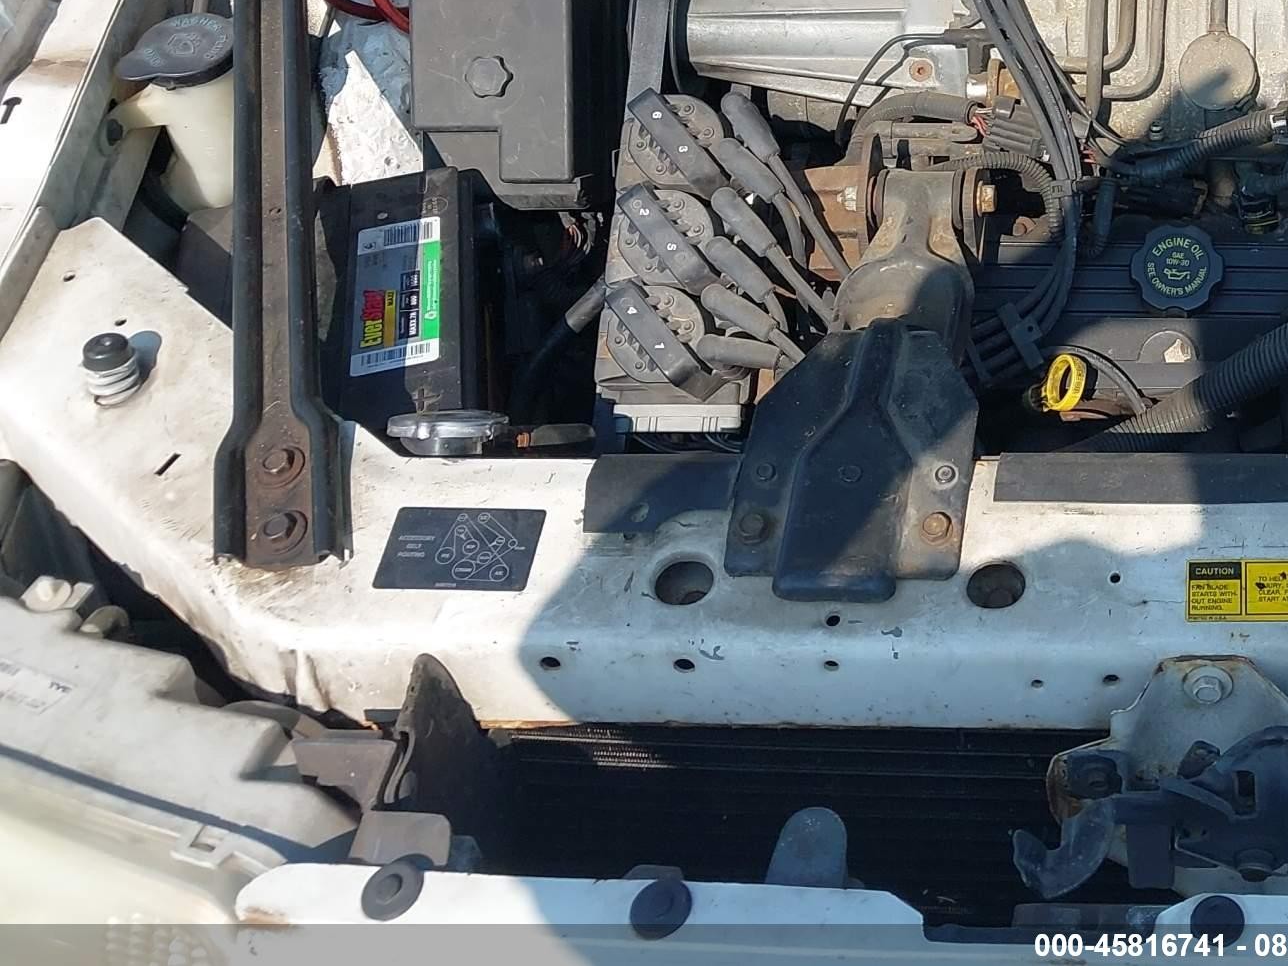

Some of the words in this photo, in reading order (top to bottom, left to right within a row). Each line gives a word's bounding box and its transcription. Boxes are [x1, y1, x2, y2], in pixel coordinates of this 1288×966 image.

[652, 111, 663, 119] 6
[678, 145, 689, 153] 3
[639, 208, 650, 216] 2
[666, 243, 677, 251] 5
[1152, 237, 1192, 257] ENGINE
[1191, 244, 1204, 260] OIL
[1171, 251, 1185, 259] SAE
[1166, 258, 1190, 267] 10W-30
[1147, 261, 1157, 278] SEE
[1184, 266, 1207, 294] MANUAL
[1151, 277, 1184, 296] OWNER'S
[627, 306, 638, 315] 4
[359, 289, 384, 348] EverStart
[654, 342, 665, 350] 1
[1195, 567, 1235, 575] CAUTION
